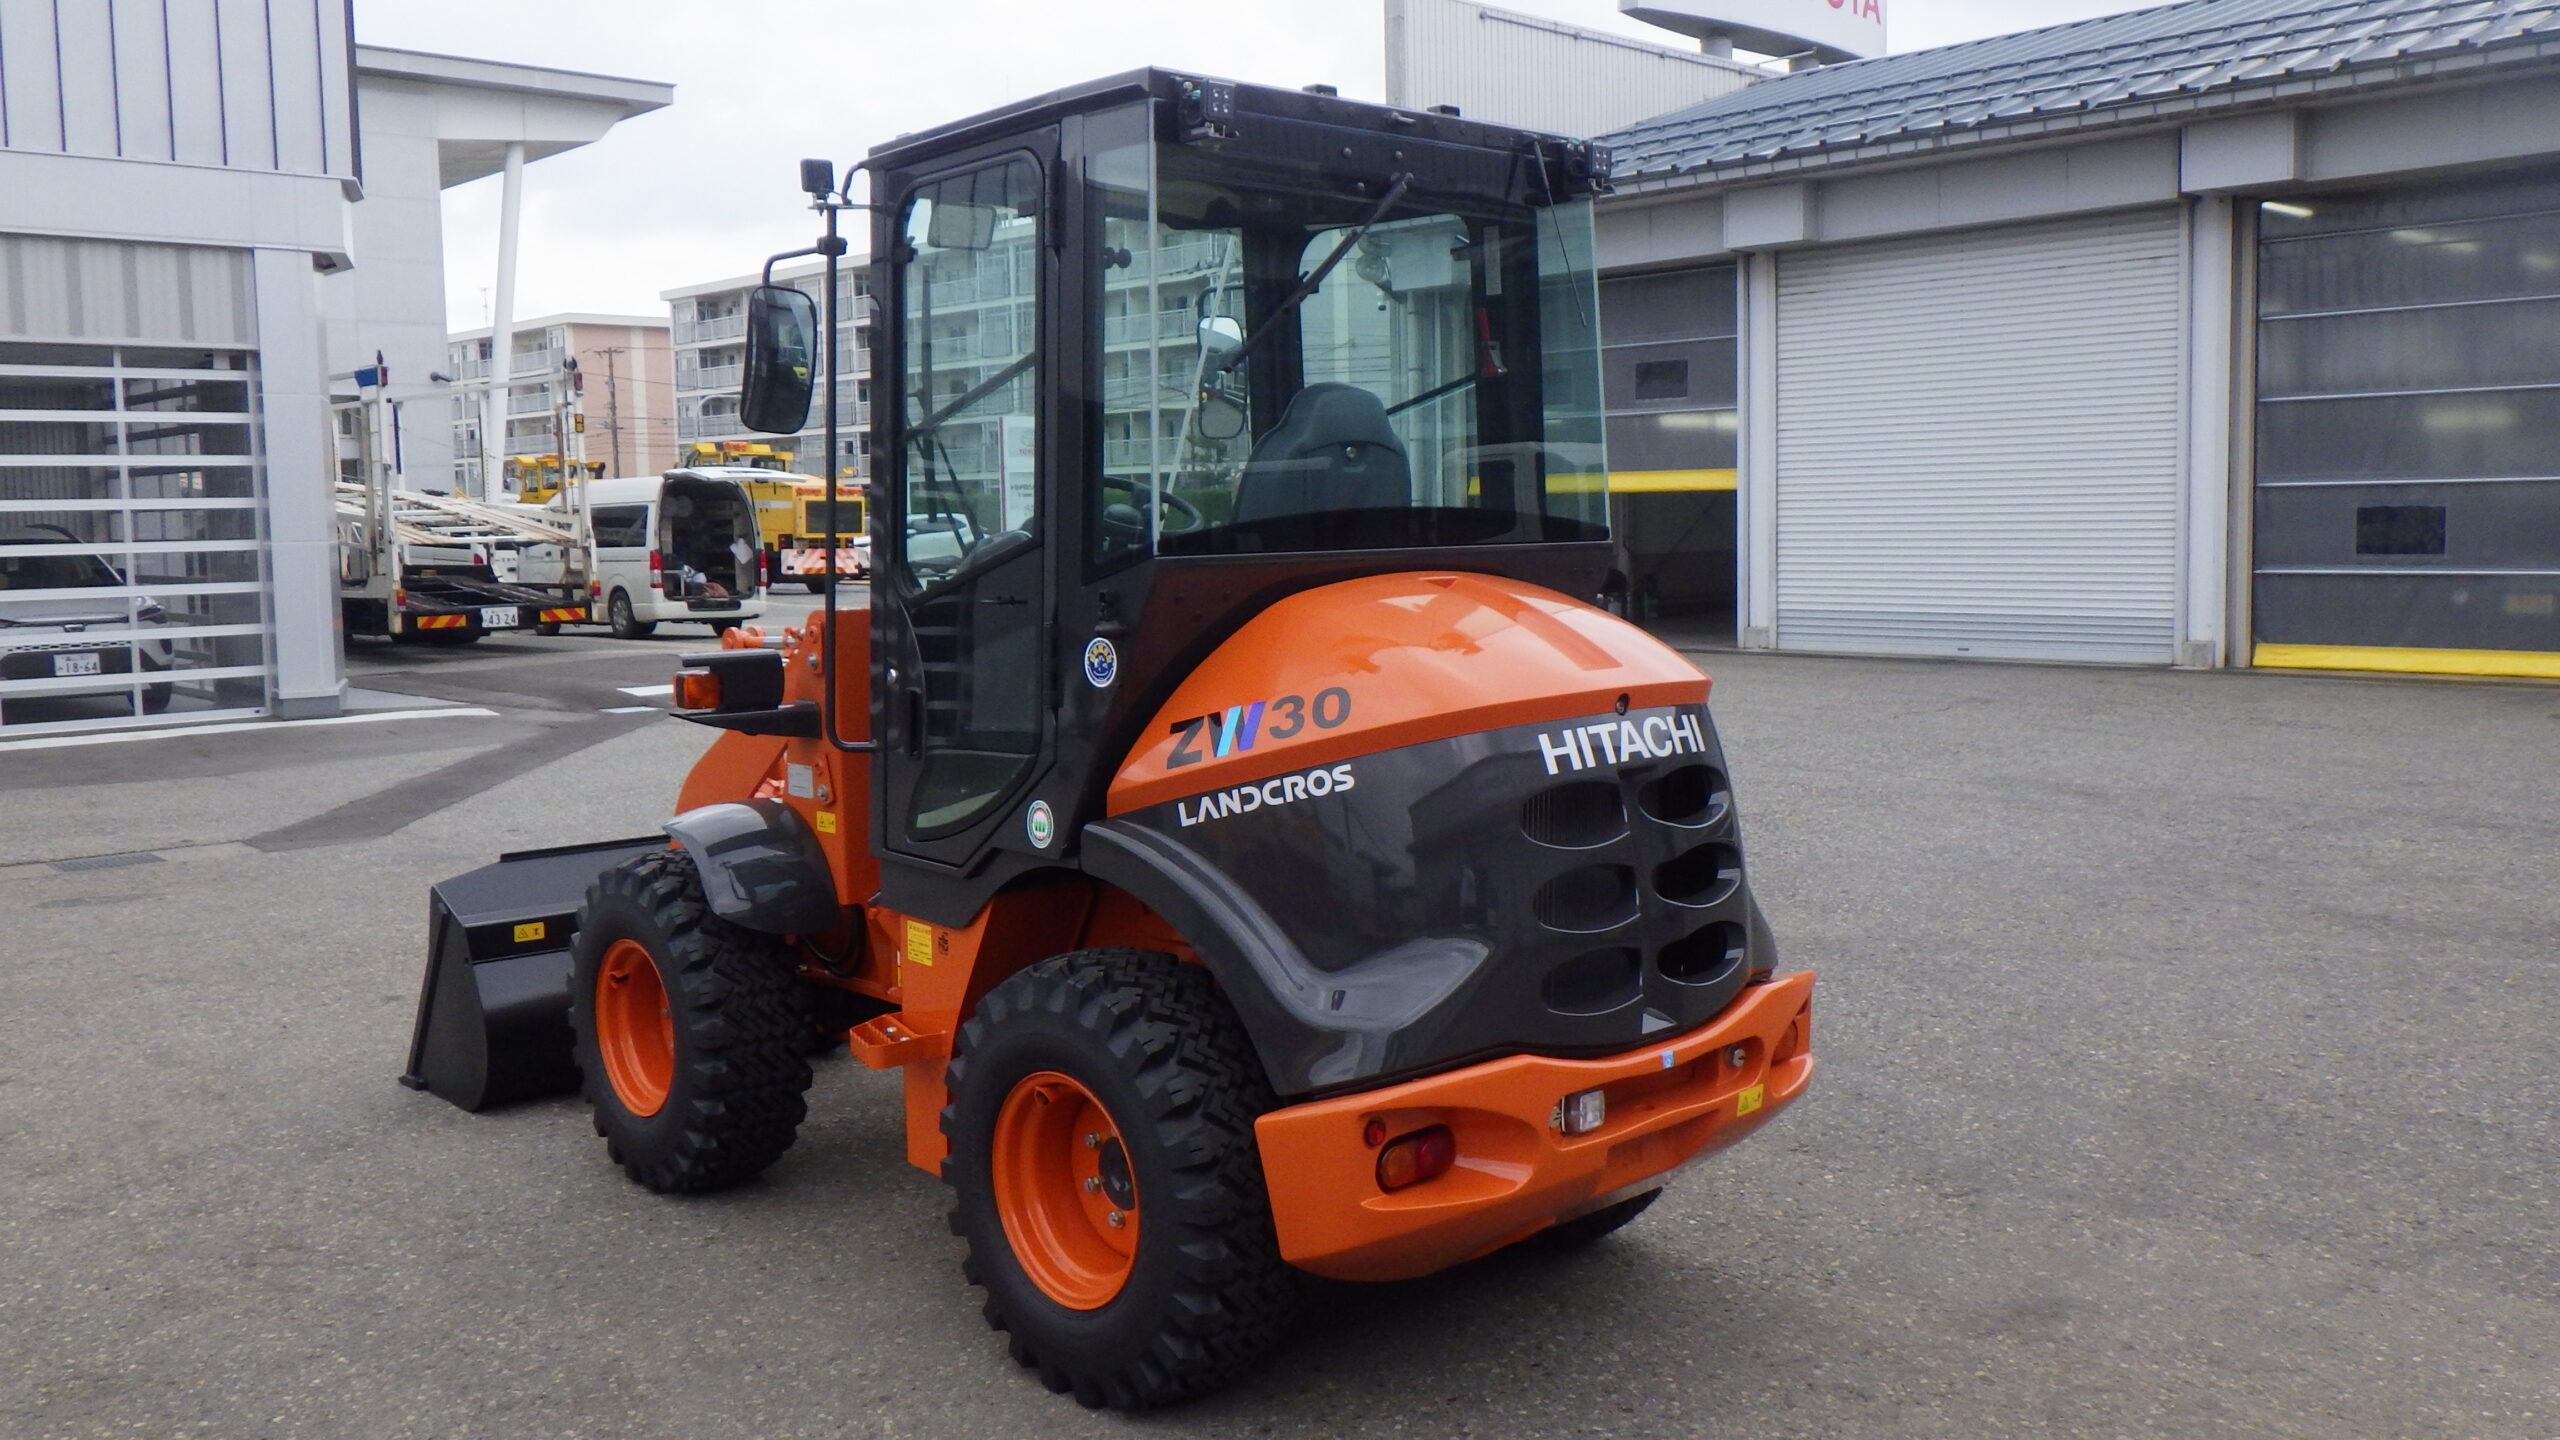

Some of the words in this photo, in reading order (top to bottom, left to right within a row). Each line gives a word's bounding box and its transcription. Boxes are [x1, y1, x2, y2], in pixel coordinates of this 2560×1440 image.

[1166, 686, 1352, 770] ZW30
[1537, 713, 1706, 776] HITACHI
[1178, 763, 1356, 828] LANDCROS
